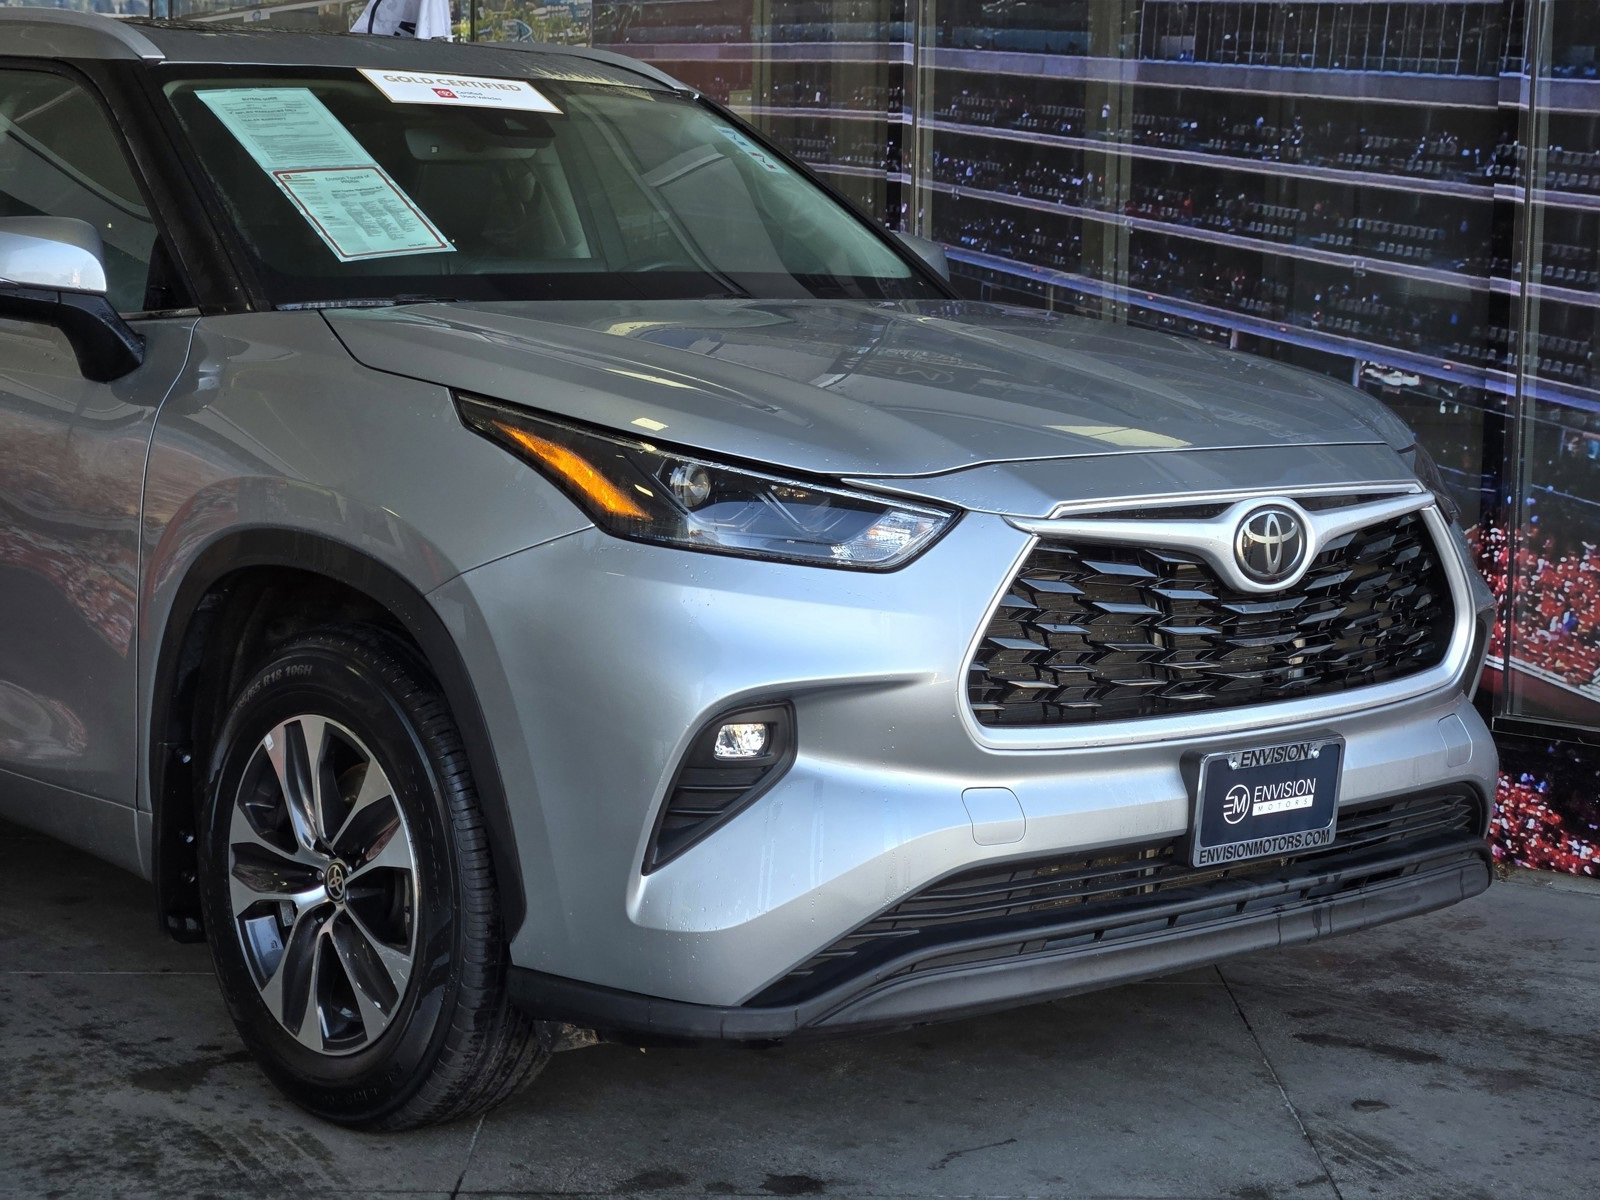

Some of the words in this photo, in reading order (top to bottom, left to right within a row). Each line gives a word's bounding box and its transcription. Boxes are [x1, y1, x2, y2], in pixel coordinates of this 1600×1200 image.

[383, 74, 434, 85] GOLD
[437, 79, 522, 92] CERTIFIED
[1240, 743, 1310, 768] ENVISION
[1253, 777, 1316, 803] ENVISION
[1257, 799, 1308, 812] MOTORS
[1199, 829, 1330, 865] ENVISIONMOTORS.COM
